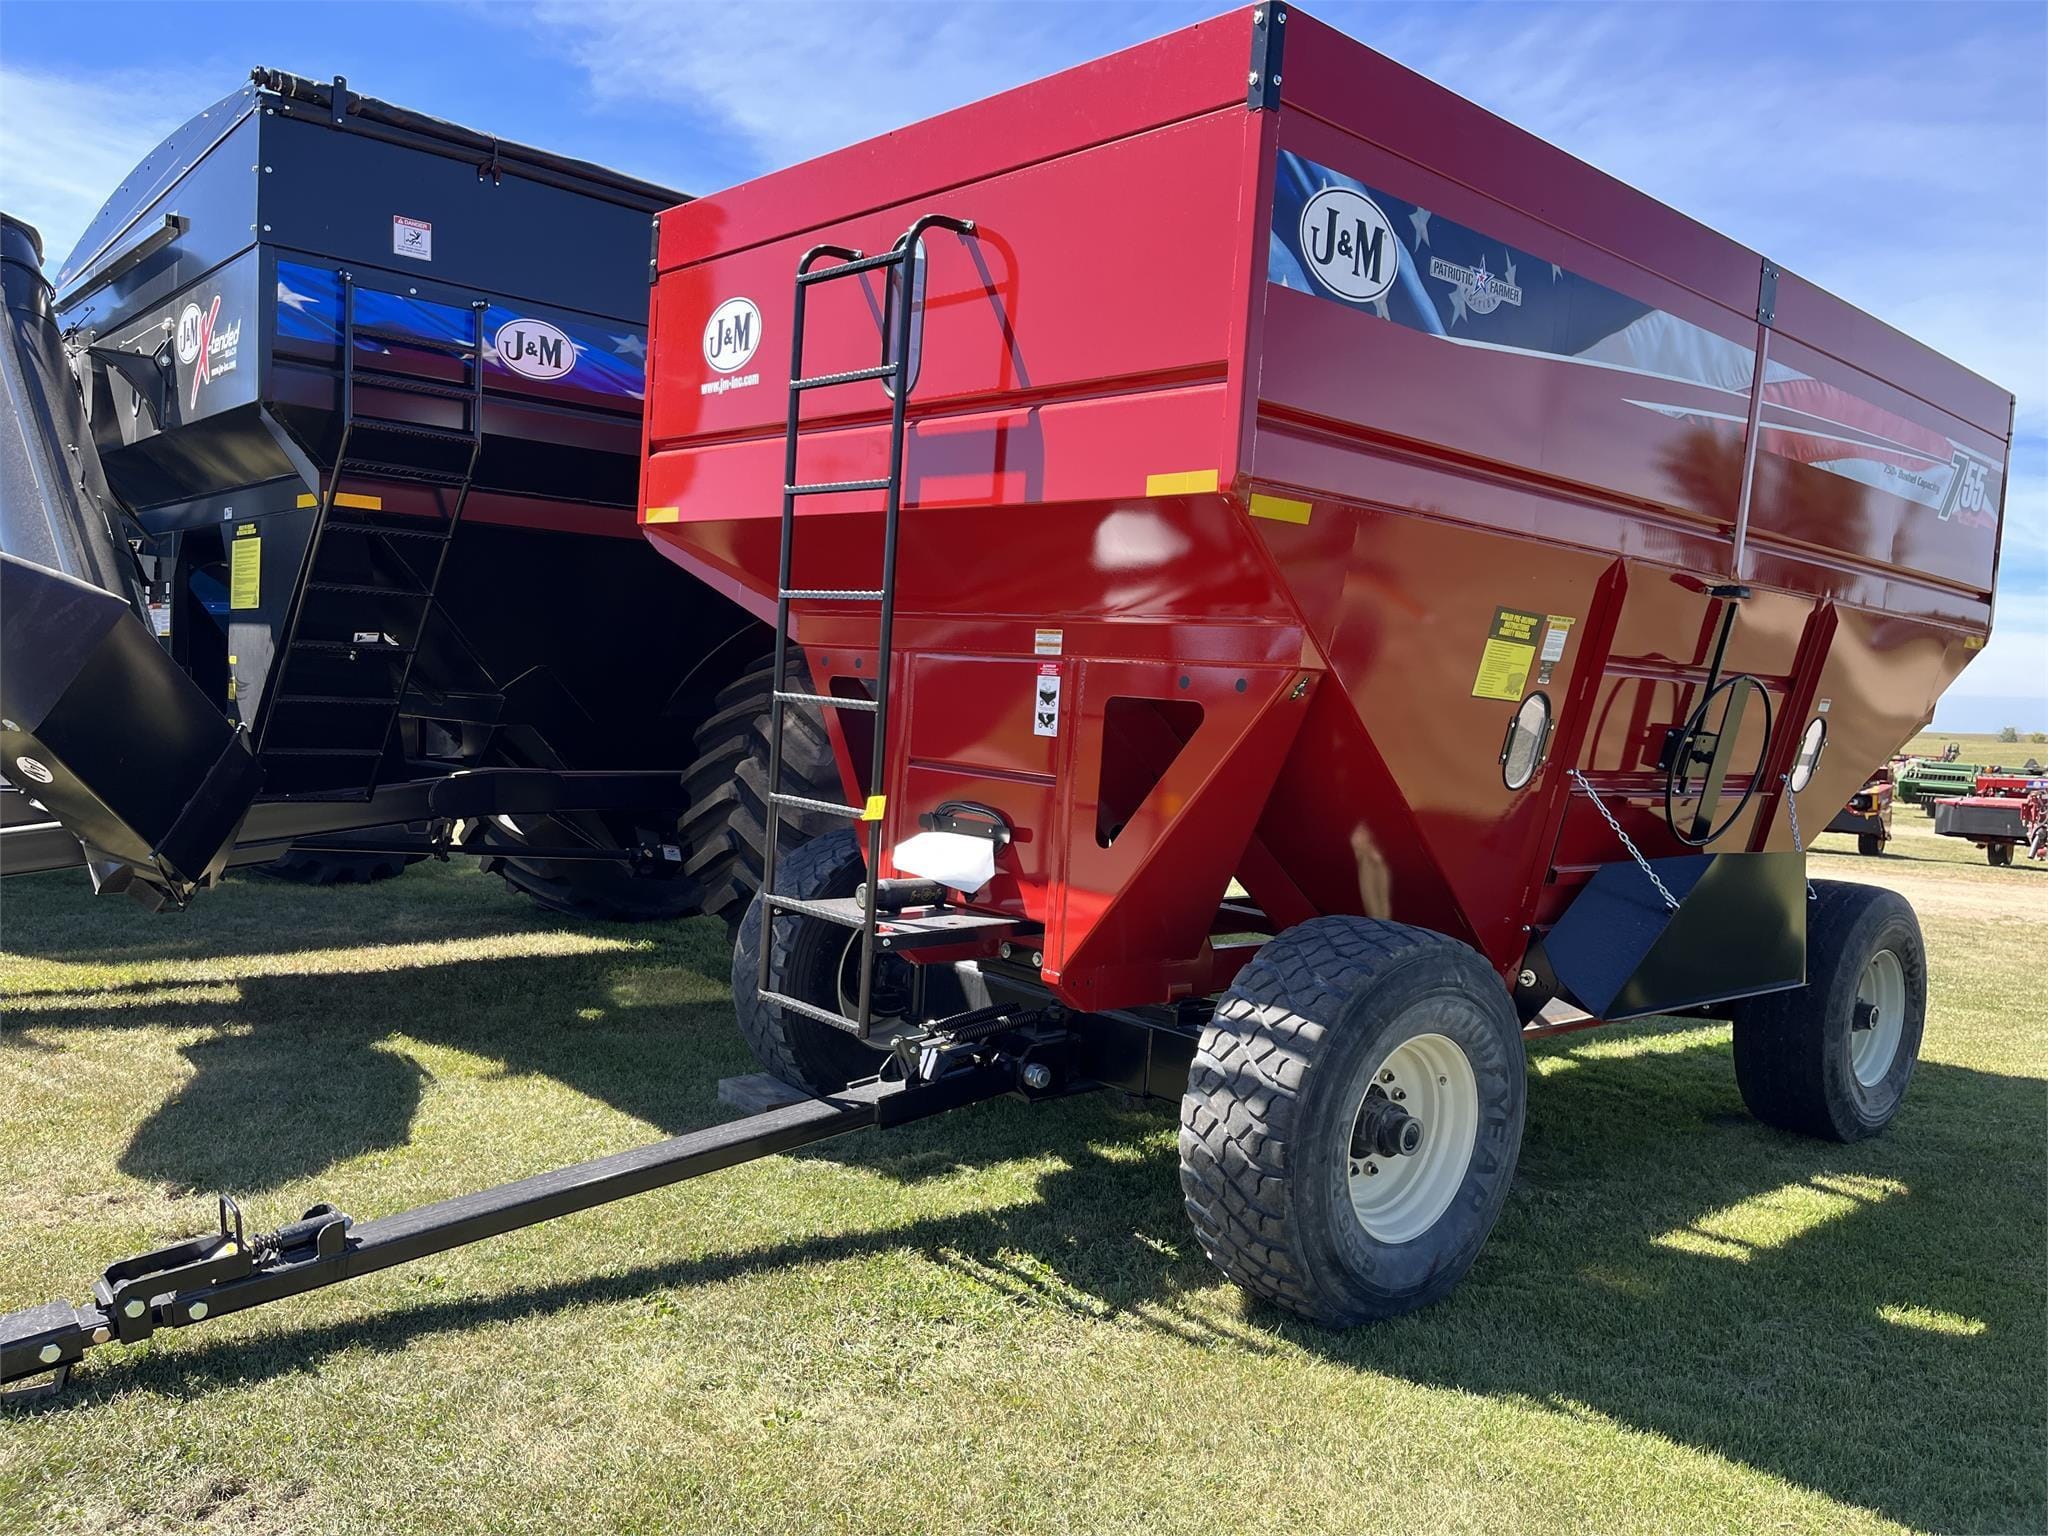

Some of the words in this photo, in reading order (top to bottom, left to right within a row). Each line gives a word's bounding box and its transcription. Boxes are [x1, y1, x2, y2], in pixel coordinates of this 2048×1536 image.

[404, 218, 428, 229] DANGER
[1310, 206, 1386, 285] J&M
[1433, 260, 1474, 286] PATRIOTIC
[1489, 280, 1519, 302] FARMER
[179, 314, 199, 353] J&M
[503, 329, 564, 369] J&M
[709, 311, 752, 359] J&M
[700, 373, 760, 395] www.jm-inc.com
[1937, 450, 1989, 522] 755
